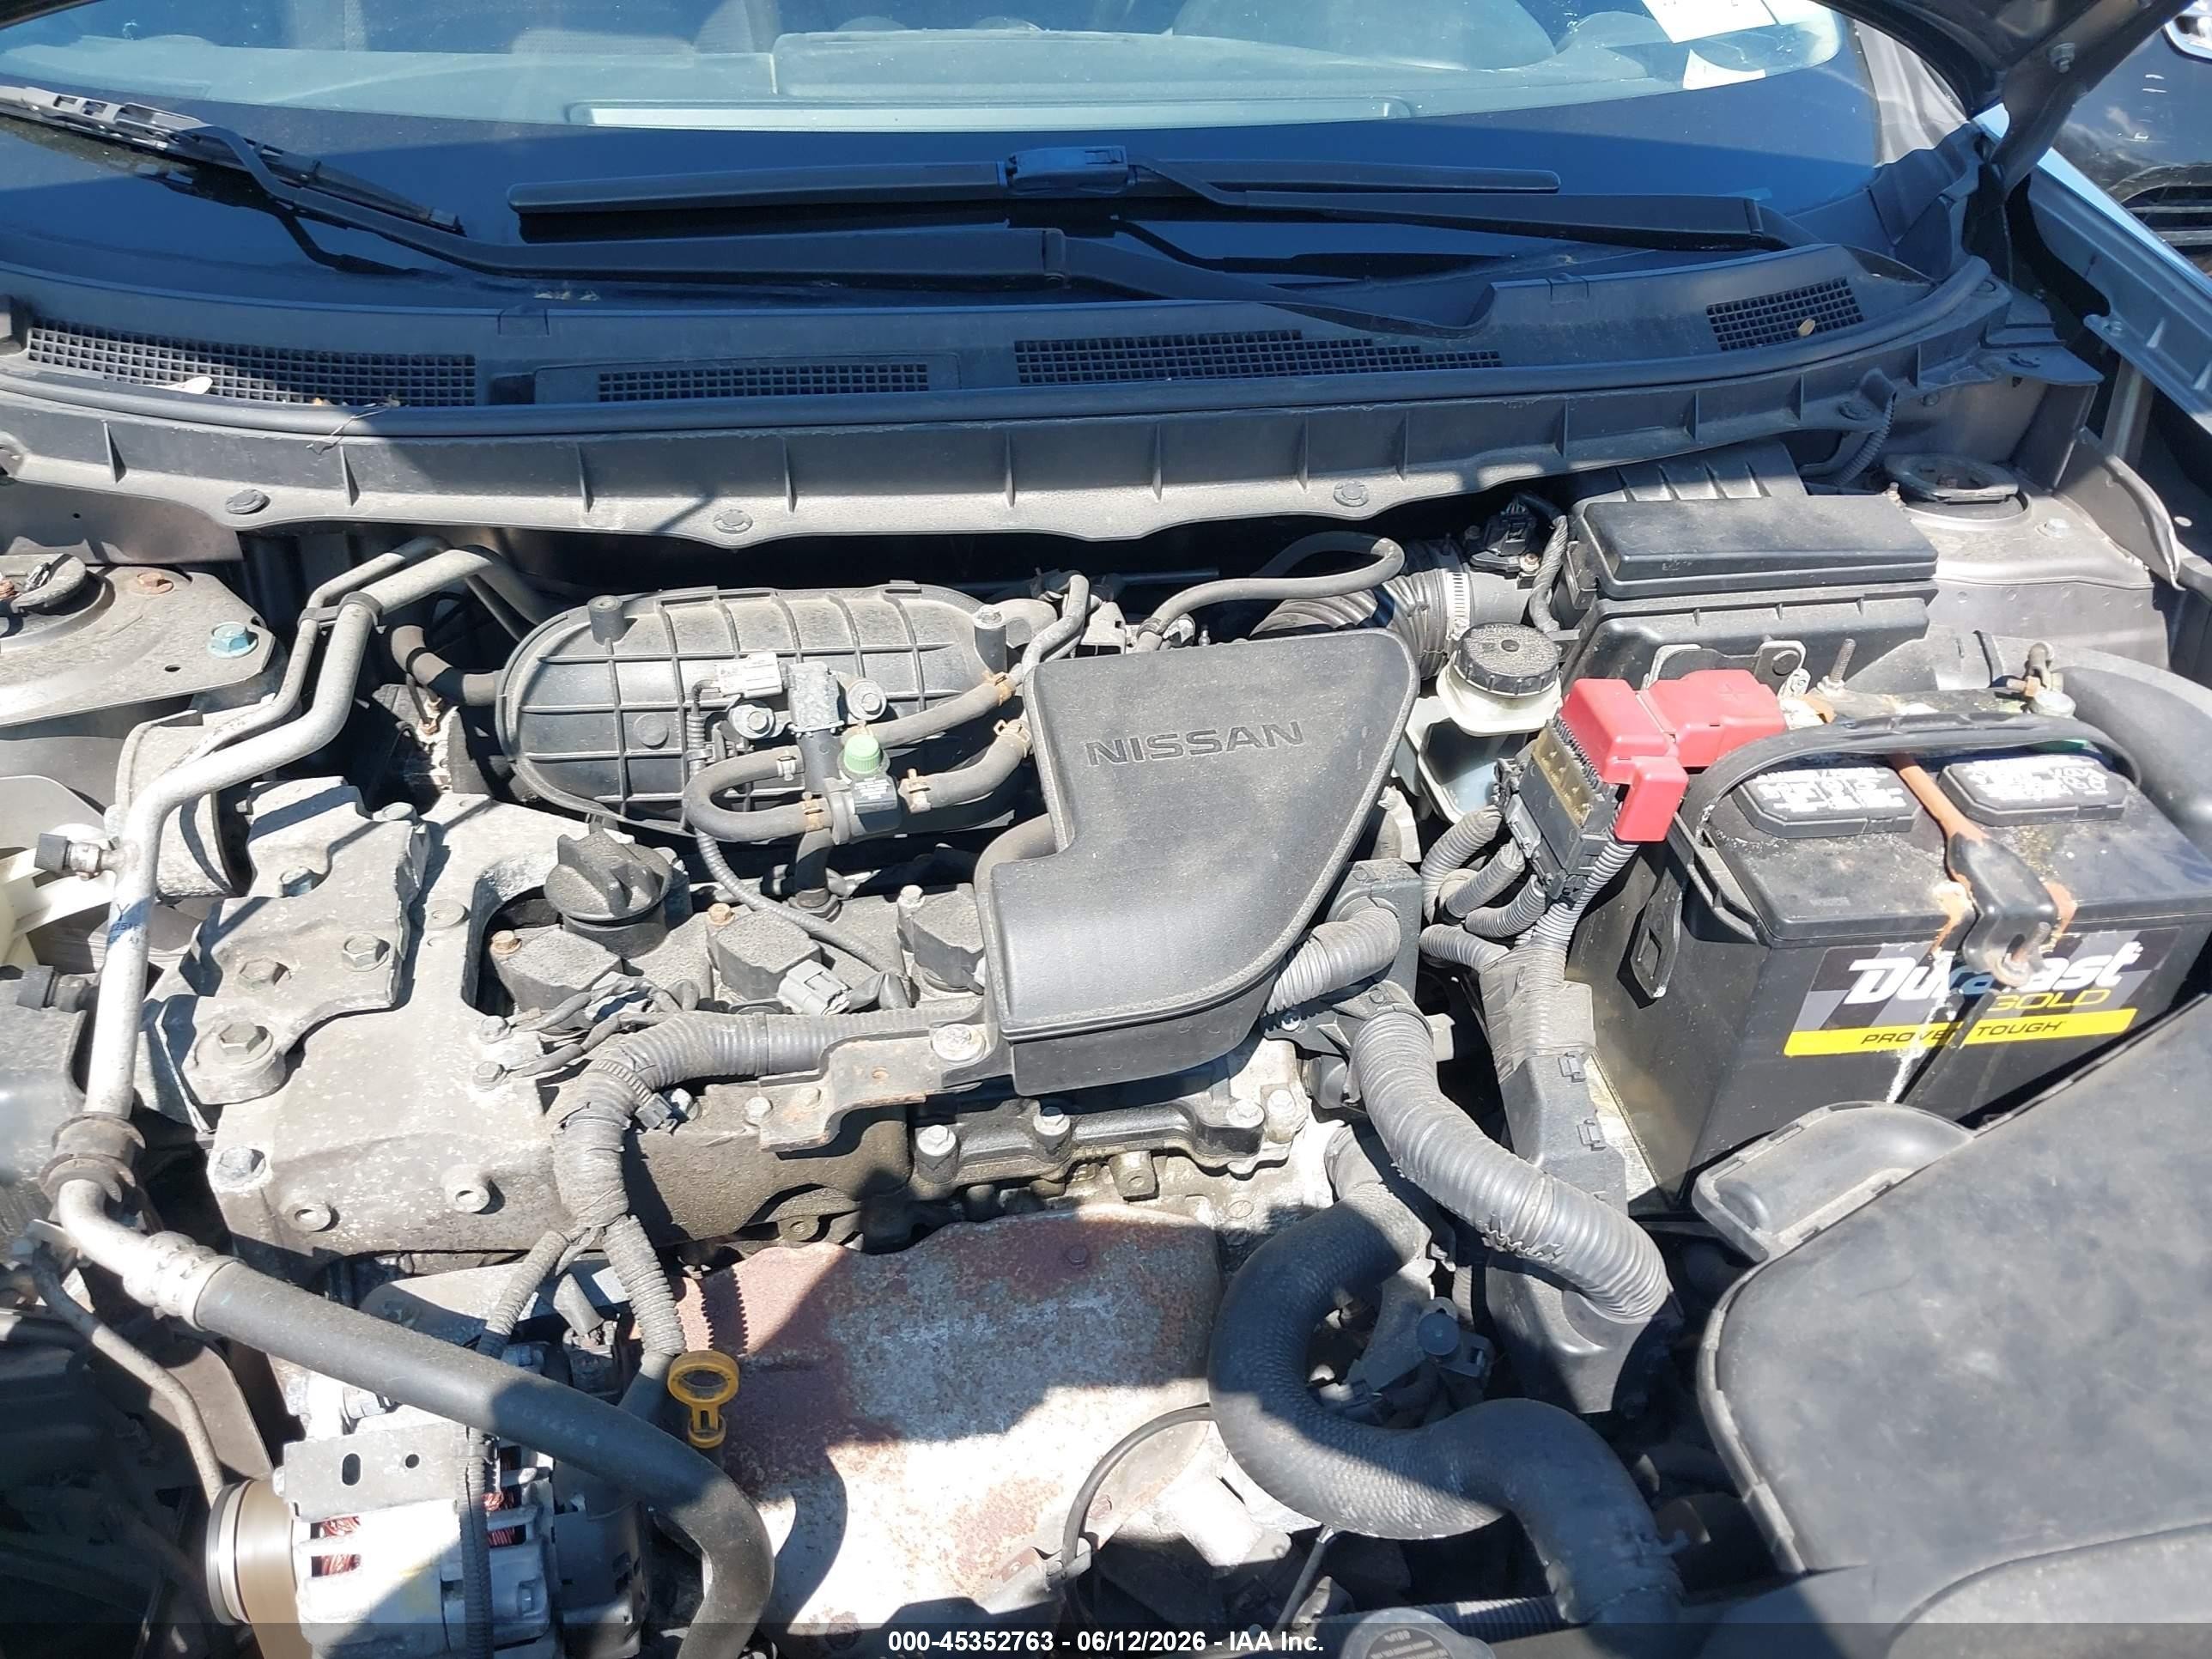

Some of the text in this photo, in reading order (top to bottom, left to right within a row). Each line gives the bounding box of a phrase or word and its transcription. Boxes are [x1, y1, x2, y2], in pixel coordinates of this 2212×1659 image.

[1085, 721, 1304, 765] NISSAN
[1844, 941, 2144, 1005] Duraast
[1978, 1021, 2063, 1036] TOUGH
